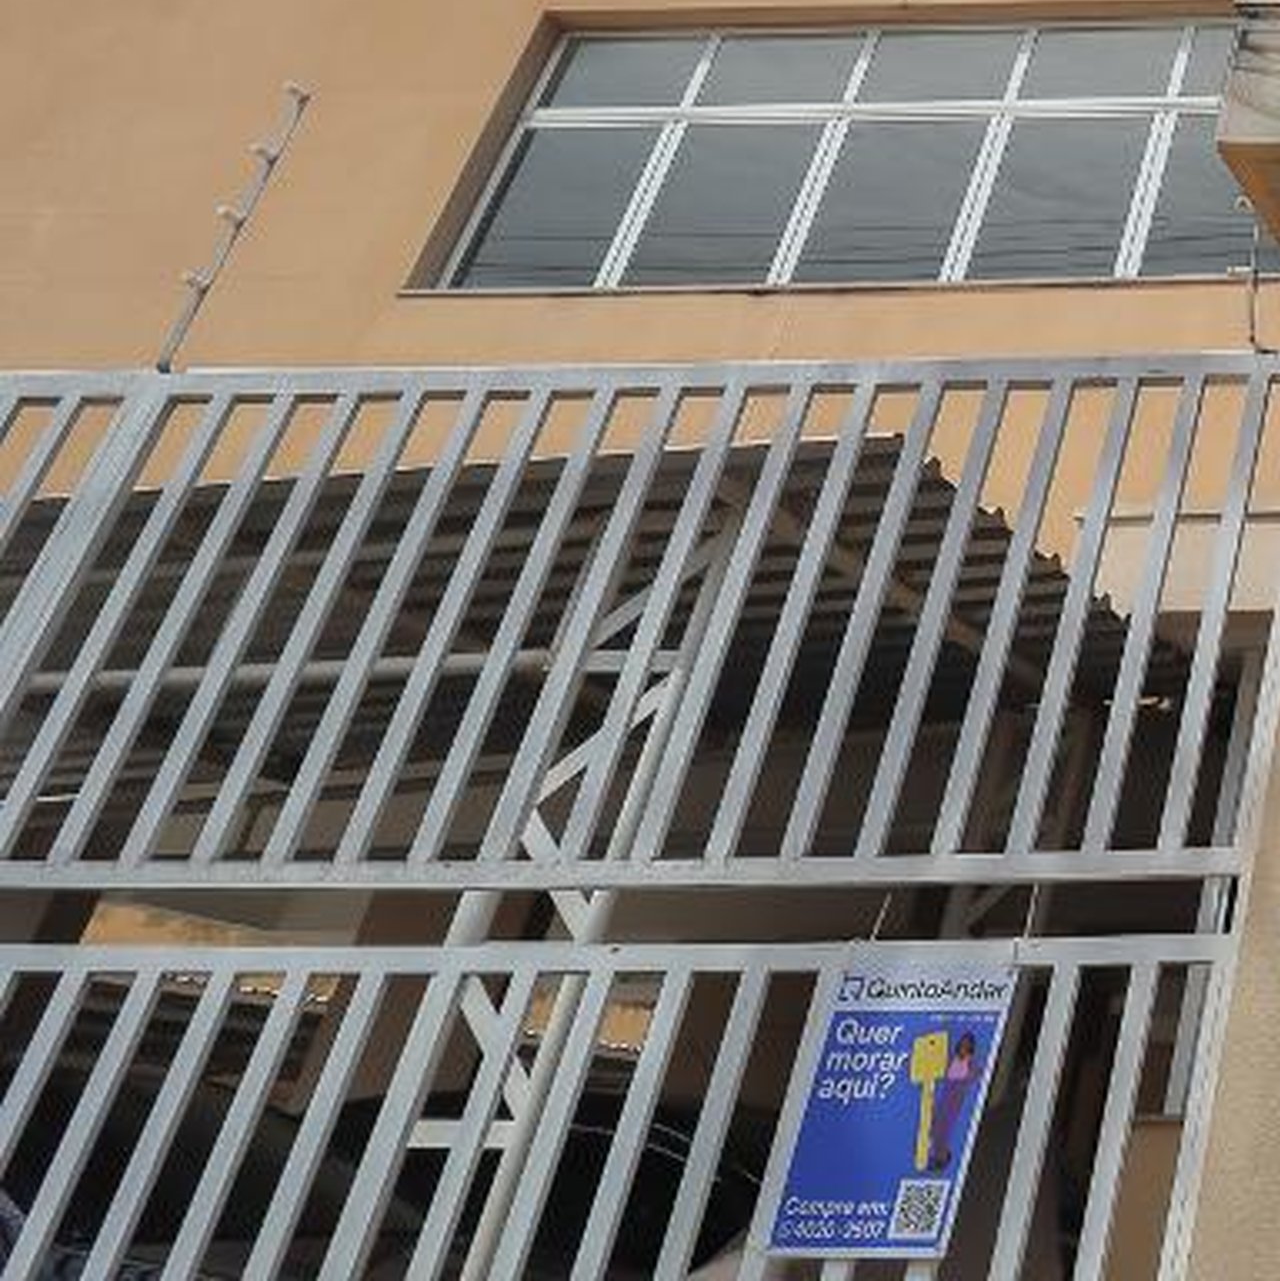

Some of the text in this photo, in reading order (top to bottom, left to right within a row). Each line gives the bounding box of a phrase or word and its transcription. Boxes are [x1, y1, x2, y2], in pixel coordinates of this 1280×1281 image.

[837, 1020, 904, 1045] Quer
[826, 1052, 908, 1072] morar
[818, 1072, 896, 1106] aqui?
